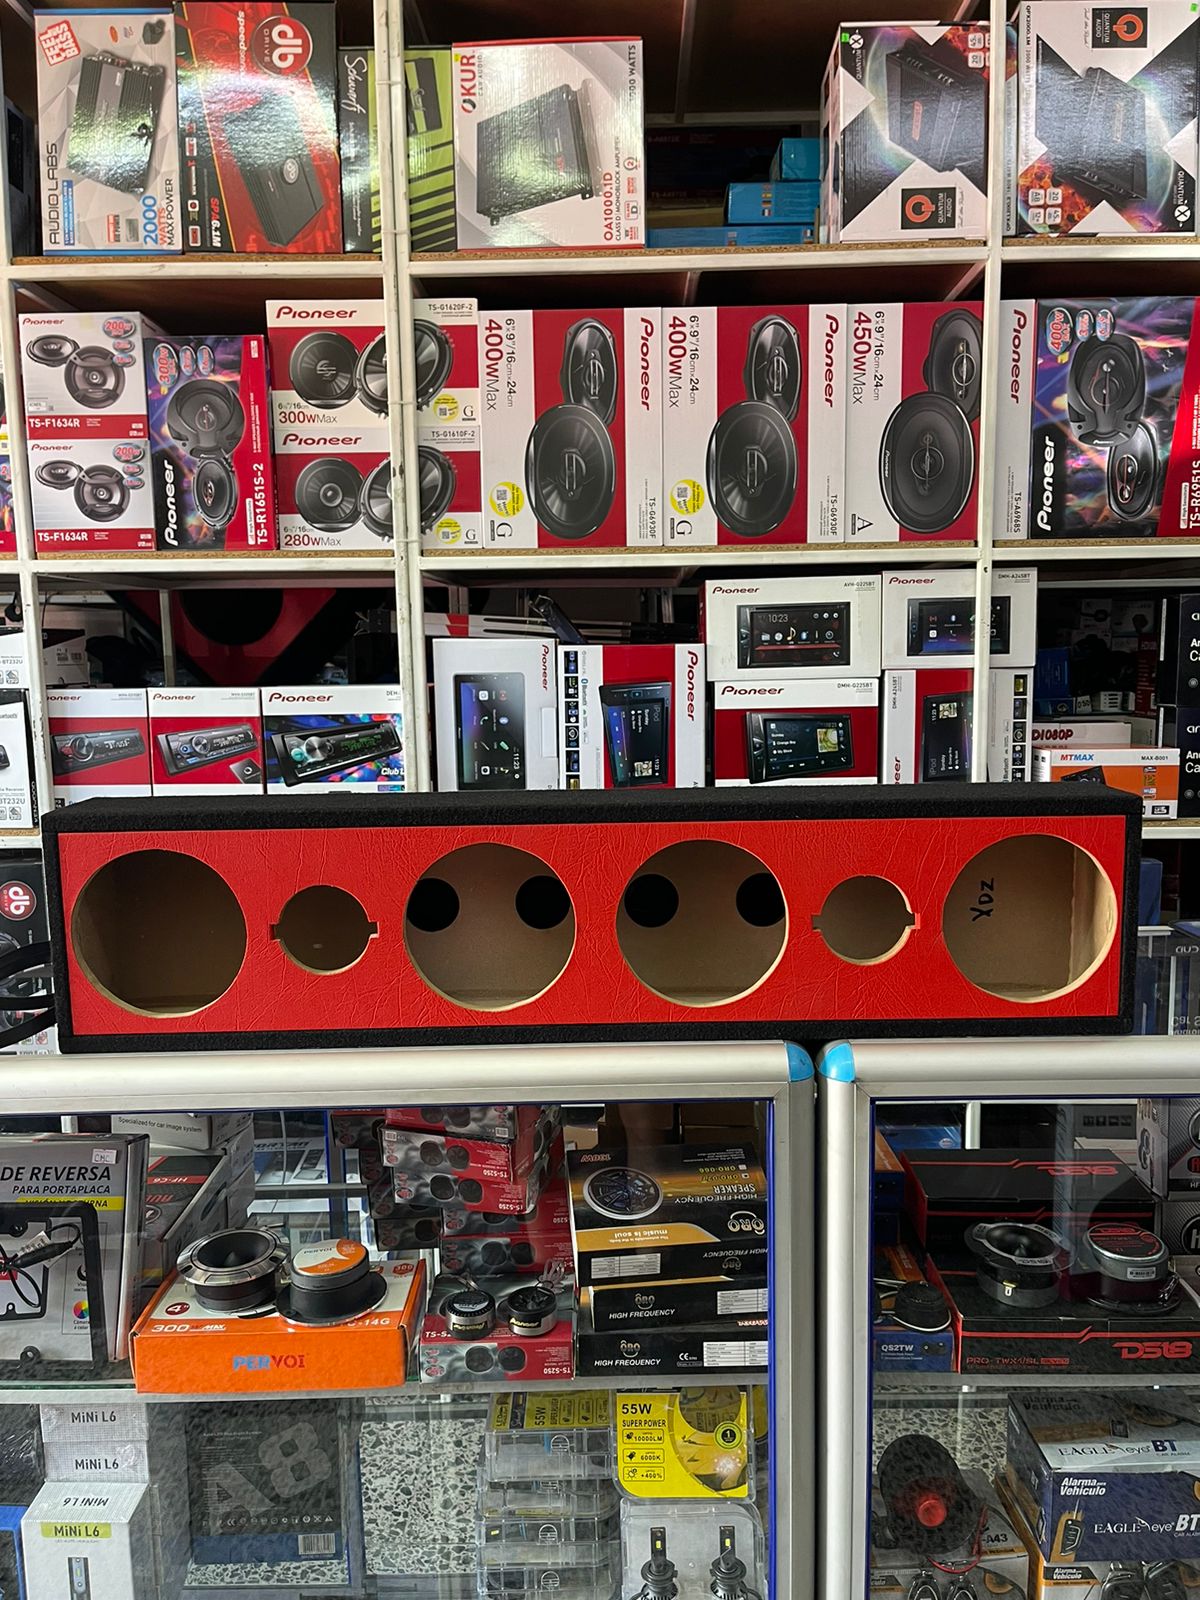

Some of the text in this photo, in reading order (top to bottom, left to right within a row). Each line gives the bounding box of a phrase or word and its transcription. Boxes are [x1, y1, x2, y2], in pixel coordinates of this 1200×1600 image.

[39, 29, 62, 64] FEEL
[56, 23, 80, 58] BASS
[271, 23, 303, 69] db
[46, 142, 60, 245] AUDIO LABS
[164, 178, 175, 246] MAX POWER
[603, 172, 613, 241] OA1000.1D
[141, 195, 158, 245] 2000
[158, 207, 167, 245] WATTS
[210, 196, 222, 247] SPA6.1M
[275, 306, 357, 319] Pioneer
[428, 303, 473, 312] TS-G1620F-2
[22, 317, 65, 326] Pioneer
[824, 313, 839, 408] Pioneer
[1010, 308, 1026, 404] Pioneer
[640, 316, 654, 411] Pioneer
[462, 404, 474, 418] G
[29, 418, 81, 428] TS-F1634R
[282, 433, 362, 446] Pioneer
[431, 430, 475, 439] TS-G1610F-2
[31, 443, 73, 451] Pioneer
[1036, 435, 1055, 532] Pioneer
[1189, 461, 1200, 529] TS-R6951S
[164, 460, 179, 547] Pioneer
[252, 463, 268, 545] TS-R1651S-2
[648, 497, 656, 539] TS-G6930F
[830, 494, 838, 536] TS-G6930F
[1013, 491, 1021, 533] TS-A6968S
[496, 522, 513, 538] G
[675, 520, 692, 536] G
[857, 516, 873, 532] A
[38, 532, 88, 541] TS-F1634R
[465, 528, 476, 542] G
[888, 576, 936, 585] Pioneer
[712, 586, 760, 594] Pioneer
[768, 613, 789, 623] 10:23
[541, 644, 550, 691] Pioneer
[686, 650, 698, 722] Pioneer
[721, 685, 784, 695] Pioneer
[152, 692, 196, 701] Pioneer
[268, 692, 334, 703] Pioneer
[653, 704, 661, 722] iPod
[381, 767, 399, 775] Club
[118, 1116, 149, 1127] Specialized
[165, 1123, 183, 1132] image
[183, 1125, 203, 1133] system
[0, 1165, 112, 1182] DE REVERSA
[482, 1169, 508, 1178] TS-S250
[12, 1184, 112, 1195] PARA PORTAPLACA
[713, 1183, 756, 1194] SPEAKER
[674, 1192, 758, 1204] HIGH FREQUENCY
[614, 1230, 632, 1238] soul
[642, 1228, 668, 1237] music
[703, 1249, 749, 1257] FREQUENCY
[609, 1308, 675, 1320] HIGH FREQUENCY
[152, 1324, 190, 1332] 300
[881, 1344, 914, 1352] QS2TW
[1111, 1340, 1192, 1360] DS18
[232, 1354, 306, 1372] PERVOI
[594, 1358, 661, 1367] HIGH FREQUENCY
[534, 1406, 546, 1426] 55W
[621, 1403, 652, 1416] 55W
[71, 1410, 117, 1424] MiNi L6
[622, 1419, 667, 1428] SUPER POWER
[1058, 1445, 1108, 1457] EAGLE
[1154, 1439, 1177, 1453] BT
[75, 1458, 119, 1470] MiNi L6
[1060, 1478, 1098, 1487] Alarma
[63, 1496, 78, 1506] L6
[54, 1524, 100, 1537] MiNi L6
[1094, 1514, 1200, 1534] EAGLE eye BT
